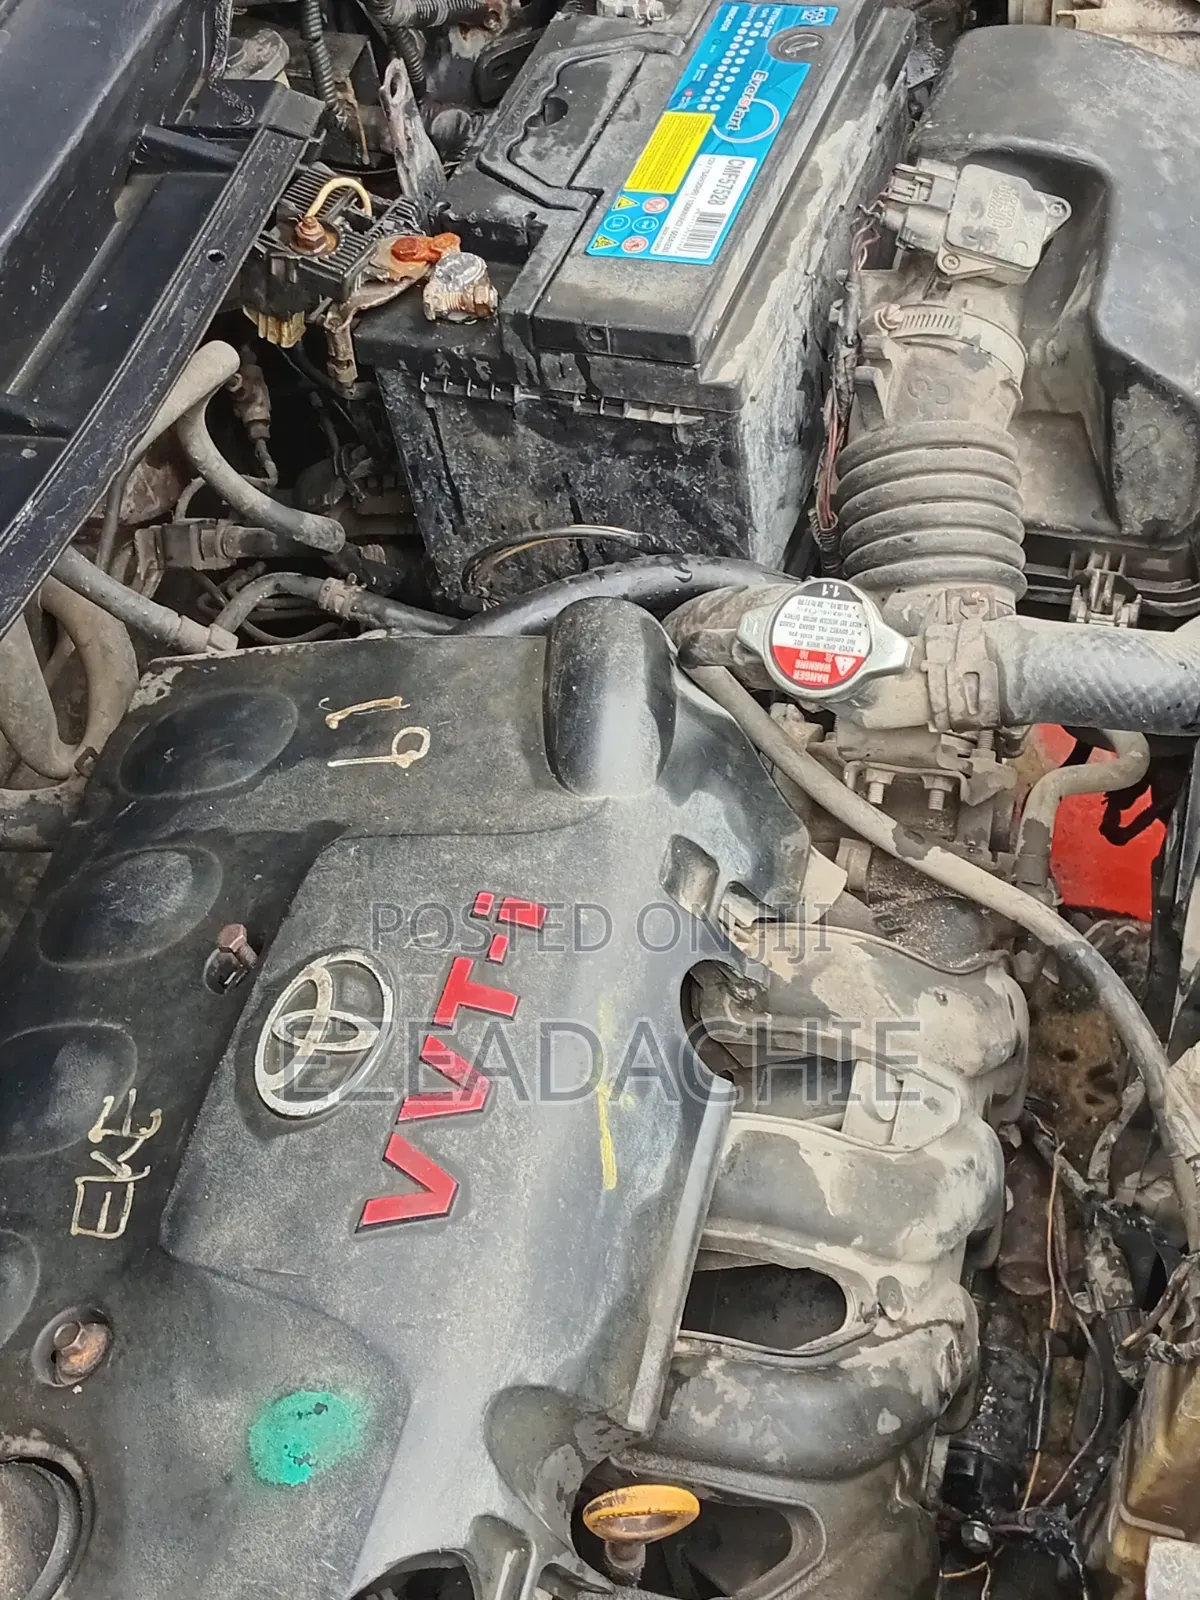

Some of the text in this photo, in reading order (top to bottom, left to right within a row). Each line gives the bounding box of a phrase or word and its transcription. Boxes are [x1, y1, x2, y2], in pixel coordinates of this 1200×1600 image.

[726, 70, 768, 130] Everstart
[708, 159, 746, 206] CMF57528
[822, 584, 840, 597] 1.1
[795, 659, 831, 673] WARNING
[793, 669, 830, 684] DANGER
